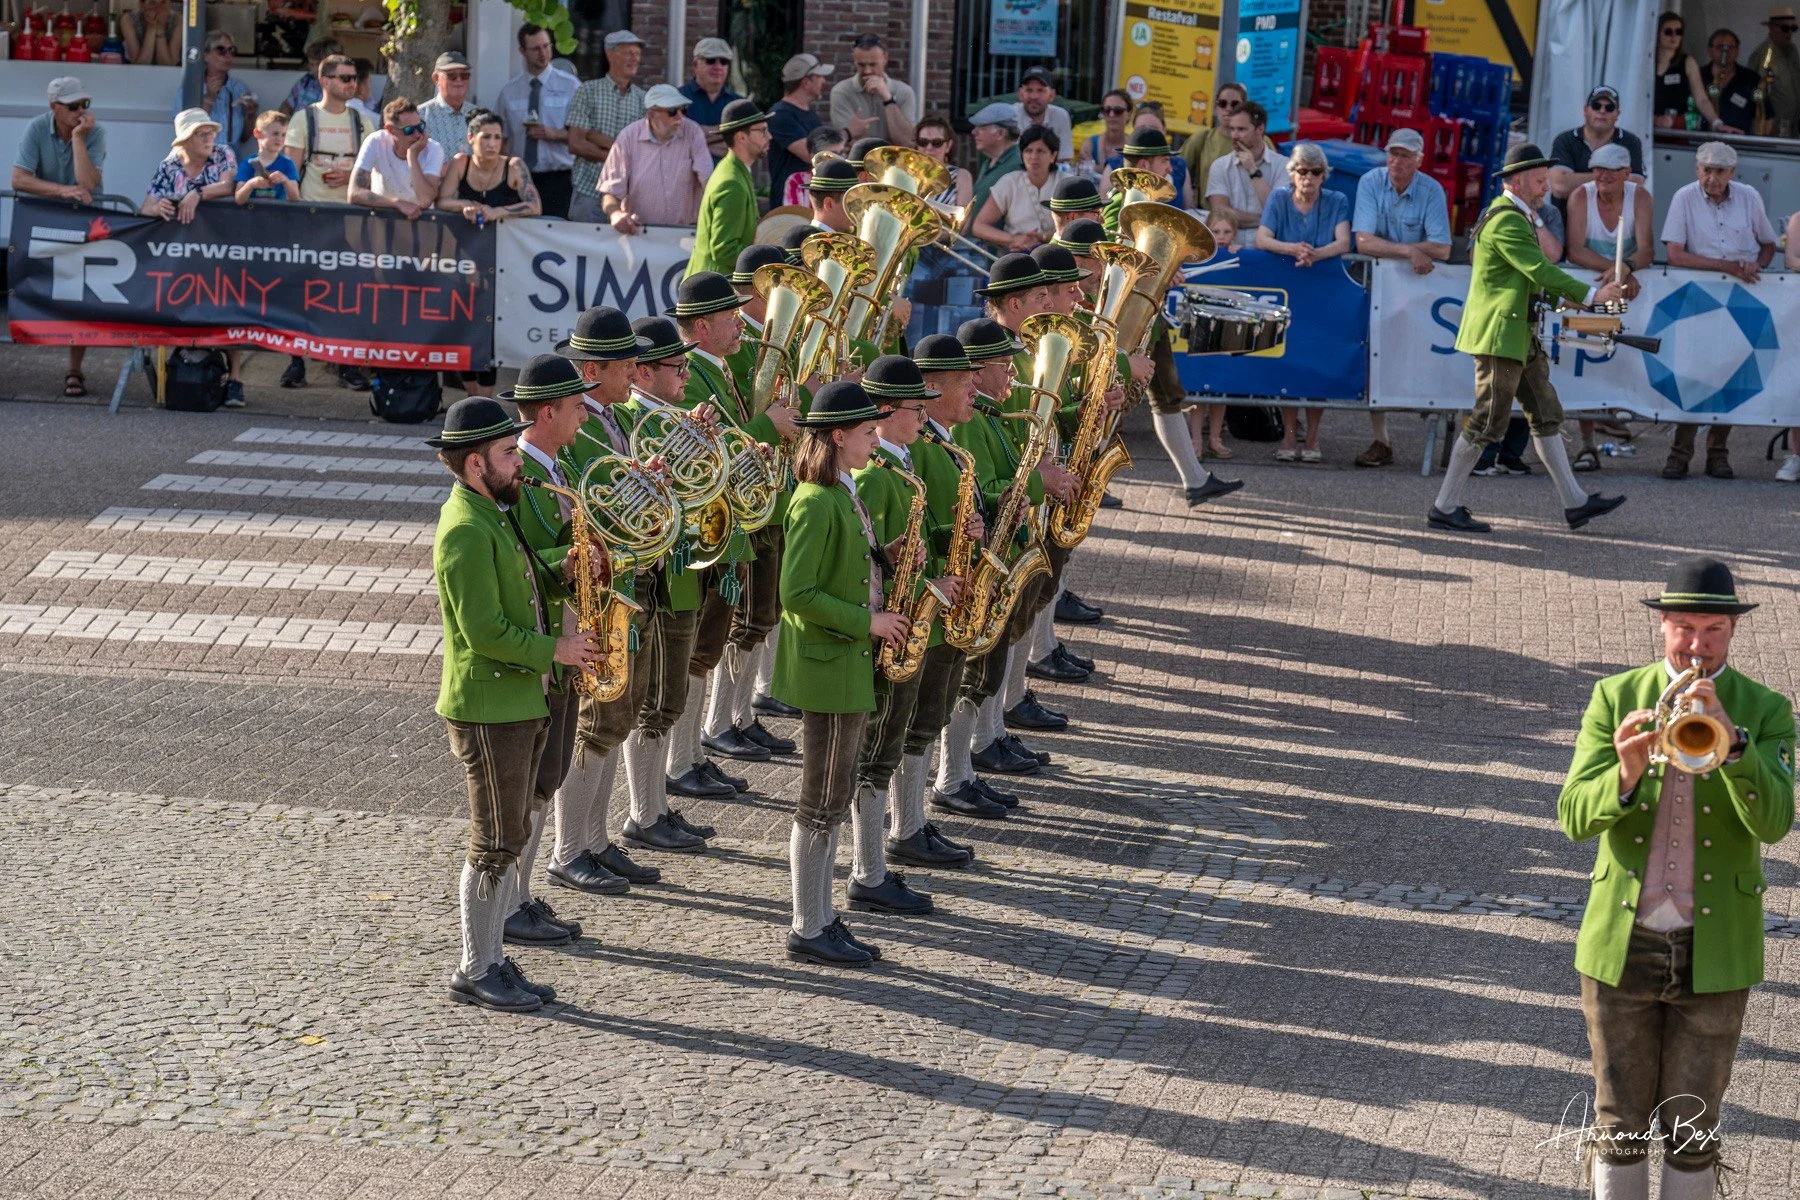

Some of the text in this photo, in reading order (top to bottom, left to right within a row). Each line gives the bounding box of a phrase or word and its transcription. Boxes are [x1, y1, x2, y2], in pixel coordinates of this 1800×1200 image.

[1148, 6, 1198, 26] Restafval
[1255, 14, 1277, 31] PMD
[147, 241, 476, 275] verwarmingsservice
[146, 266, 477, 325] TONNY RUTTEN
[226, 328, 459, 364] WWW.RUTTENCV.BE
